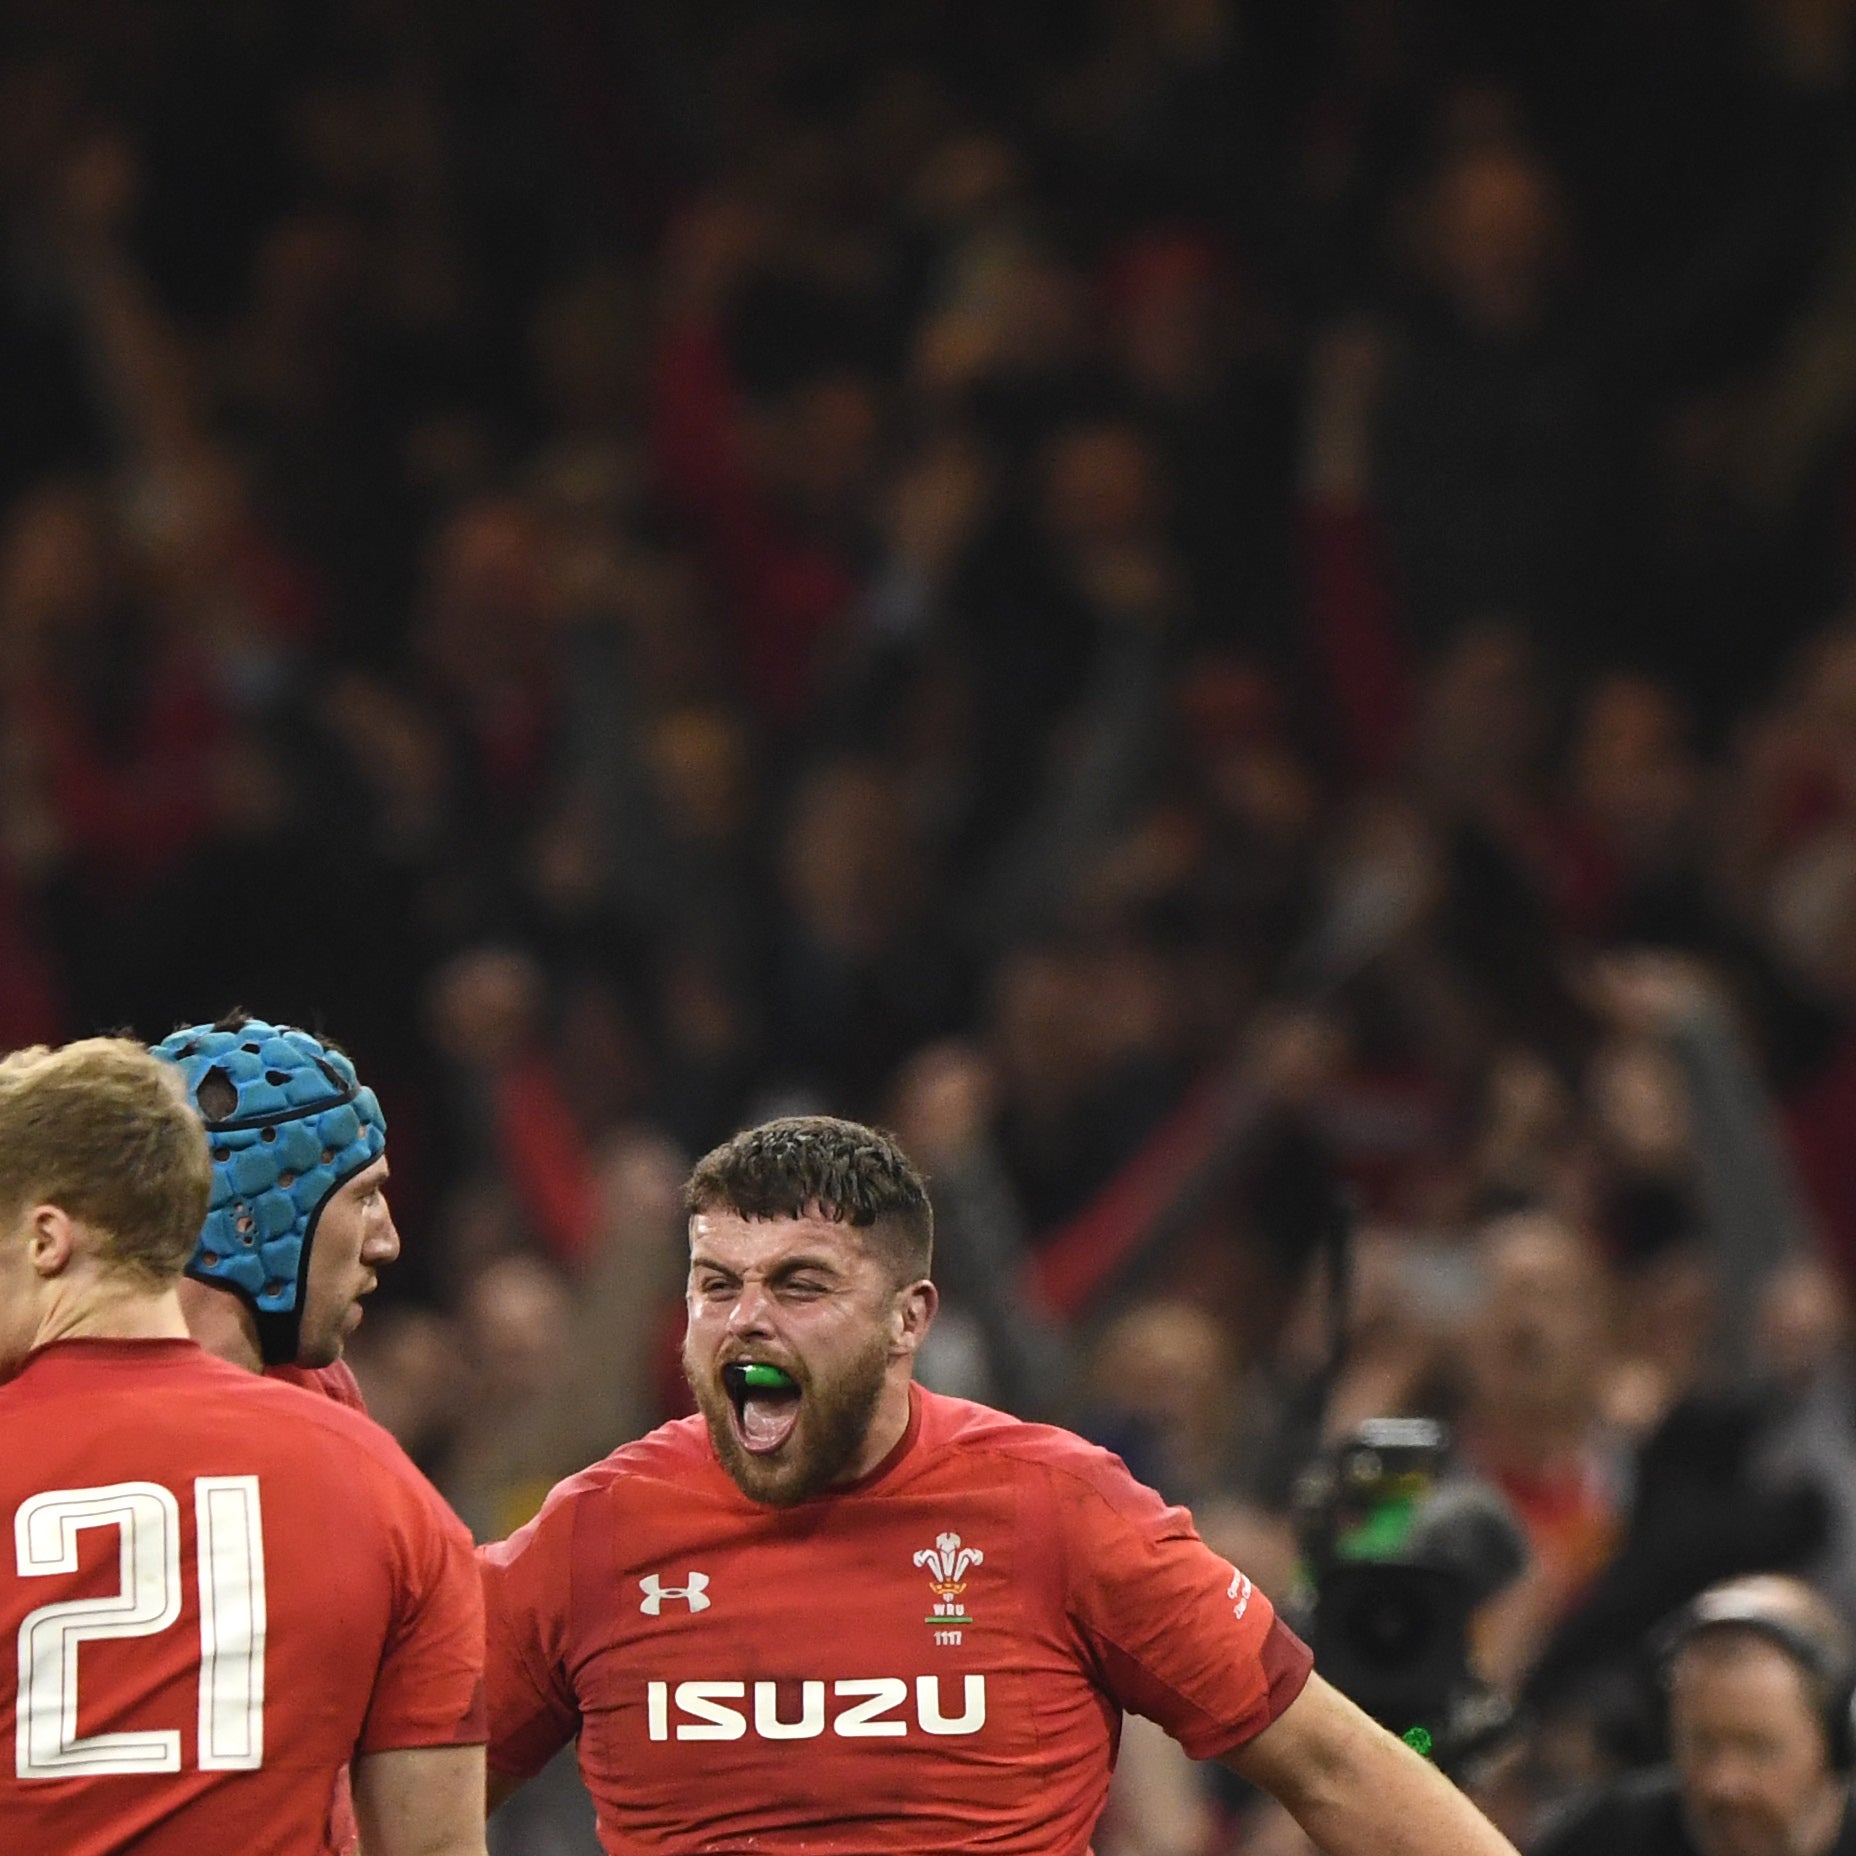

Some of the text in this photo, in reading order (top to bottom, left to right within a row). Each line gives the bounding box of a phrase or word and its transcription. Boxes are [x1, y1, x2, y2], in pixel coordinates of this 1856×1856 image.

[14, 1475, 266, 1779] 21
[933, 1603, 965, 1616] WRU
[647, 1674, 986, 1741] ISUZU
